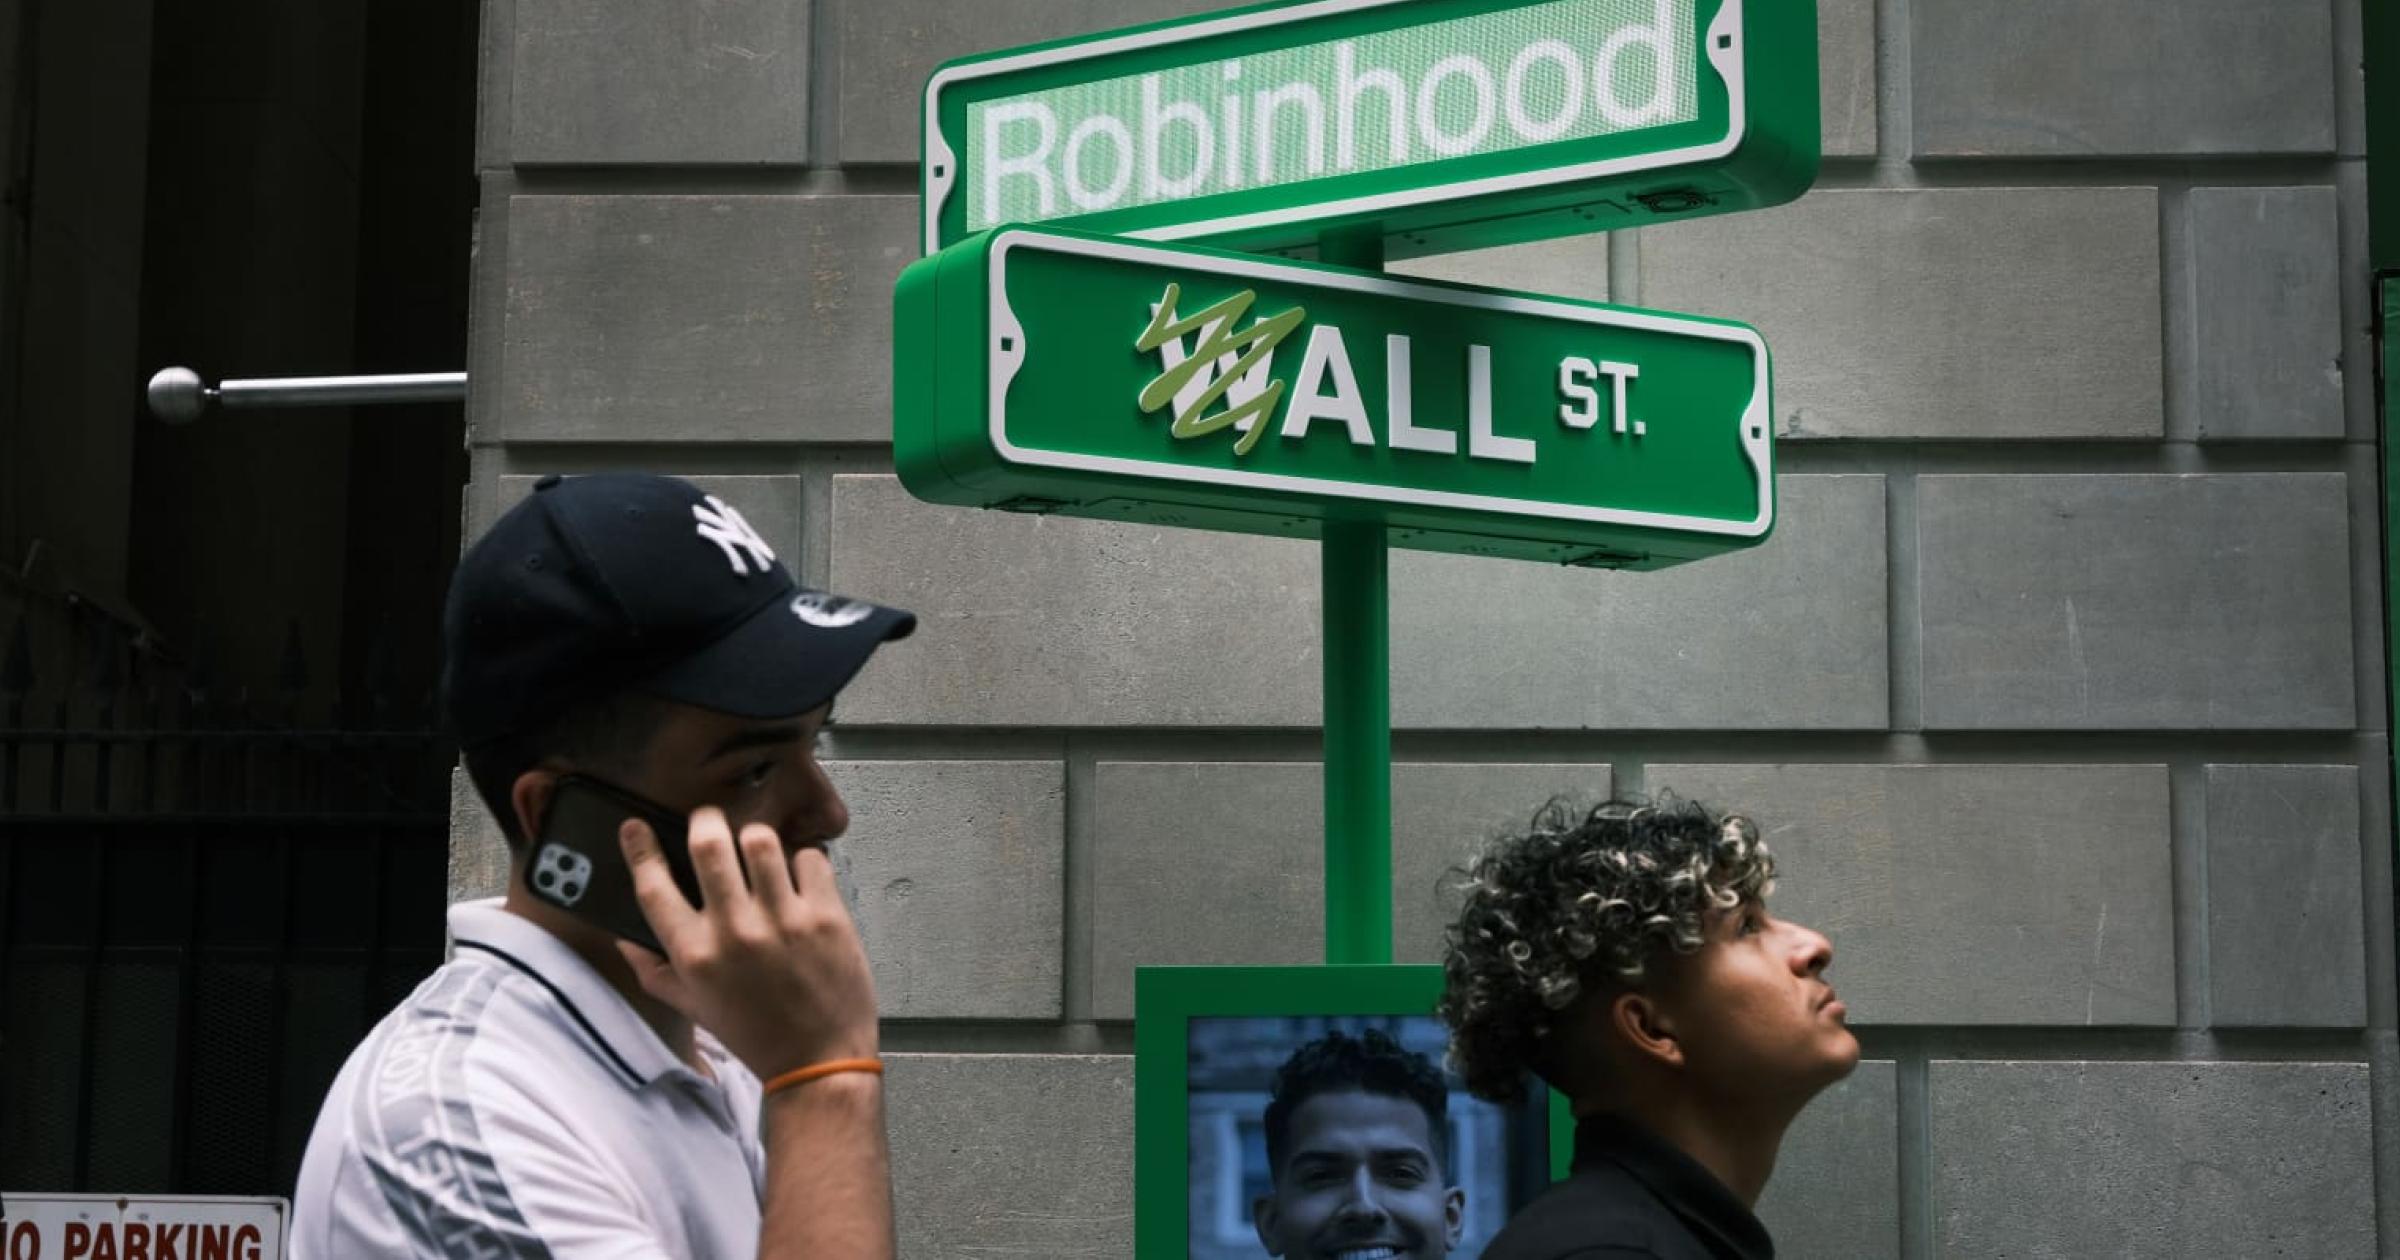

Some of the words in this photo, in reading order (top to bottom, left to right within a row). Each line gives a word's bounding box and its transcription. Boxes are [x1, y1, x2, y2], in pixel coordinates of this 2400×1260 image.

[983, 0, 1677, 223] Robinhood
[1558, 356, 1646, 436] ST.
[0, 1220, 41, 1260] O
[63, 1221, 262, 1260] PARKING
